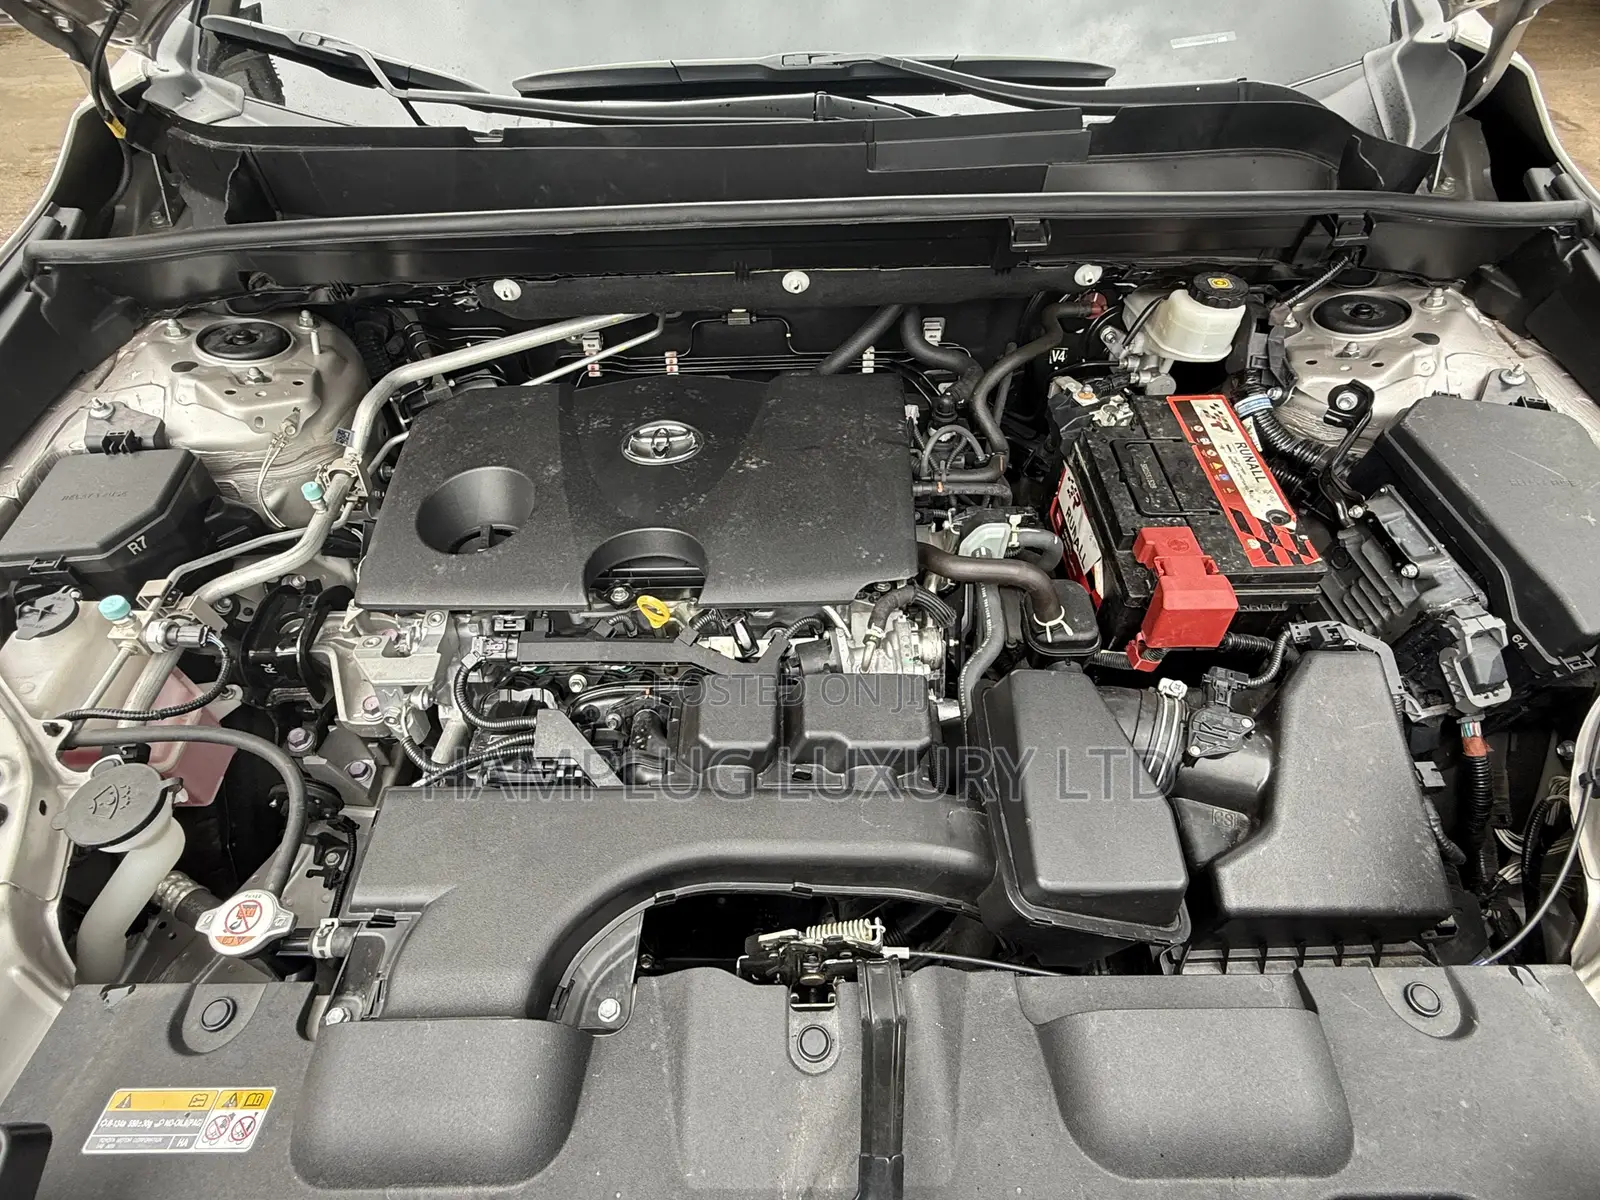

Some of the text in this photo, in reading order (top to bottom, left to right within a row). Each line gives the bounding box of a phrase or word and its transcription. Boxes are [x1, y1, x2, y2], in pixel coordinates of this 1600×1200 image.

[1235, 441, 1266, 483] RUNALL
[127, 535, 148, 555] R7
[1065, 506, 1085, 570] RUNALL
[1511, 634, 1528, 650] 64
